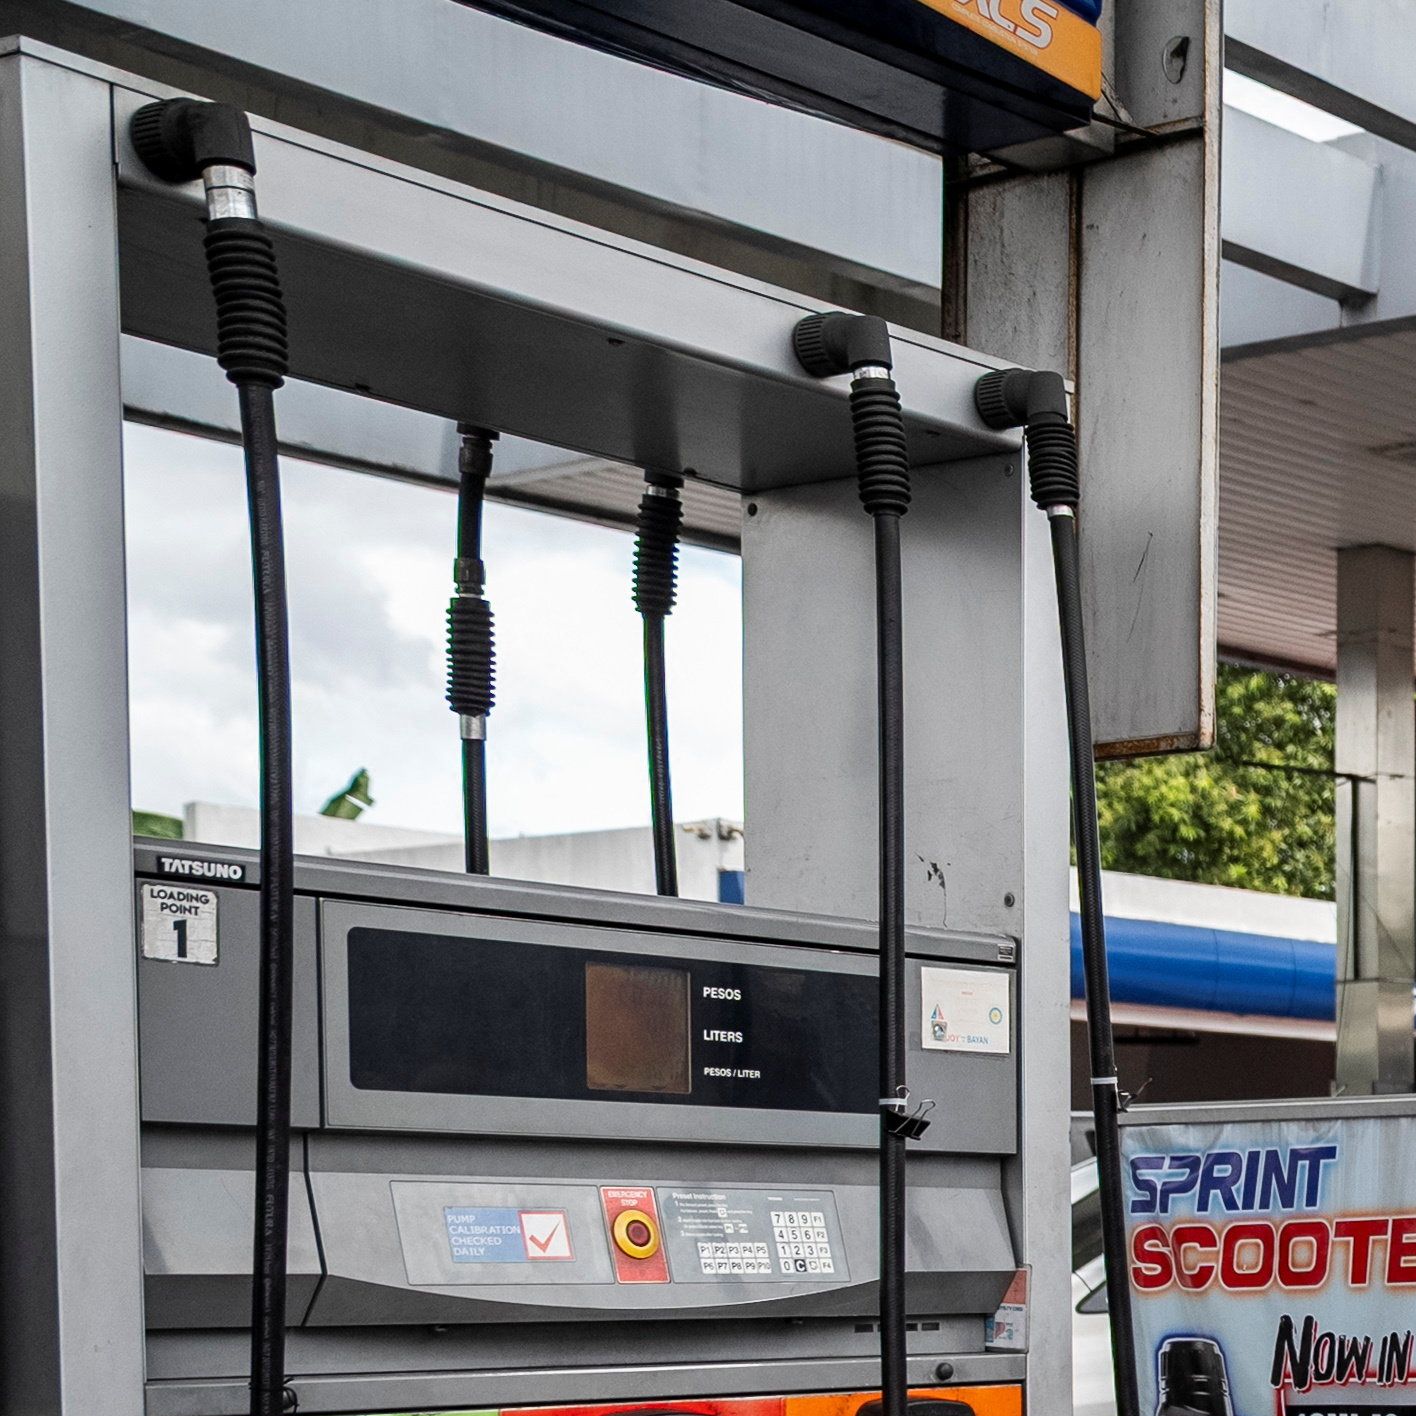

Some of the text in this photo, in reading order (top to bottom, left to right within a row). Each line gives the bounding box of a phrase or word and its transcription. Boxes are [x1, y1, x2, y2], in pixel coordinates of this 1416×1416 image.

[160, 857, 243, 880] TATSUNO
[150, 887, 210, 905] LOADING
[160, 902, 200, 917] POINT
[173, 918, 188, 959] 1
[703, 986, 741, 1001] PESOS
[703, 1029, 743, 1043] LITERS
[704, 1067, 731, 1077] PESOS
[737, 1069, 760, 1079] LITER
[1130, 1144, 1338, 1214] SPRINT
[620, 1199, 638, 1207] STOP
[447, 1214, 476, 1224] PUMP
[775, 1214, 781, 1224] 7
[788, 1214, 795, 1224] 8
[801, 1214, 808, 1224] 9
[449, 1226, 520, 1235] CALIBRATION
[778, 1230, 784, 1240] 4
[791, 1230, 798, 1240] 5
[804, 1230, 811, 1240] 6
[451, 1236, 502, 1246] CHECKED
[453, 1247, 486, 1256] DAILY
[714, 1246, 725, 1255] P2
[794, 1245, 801, 1255] 2
[808, 1245, 814, 1255] 3
[718, 1262, 728, 1271] P7
[784, 1260, 790, 1271] 0
[796, 1260, 806, 1271] C
